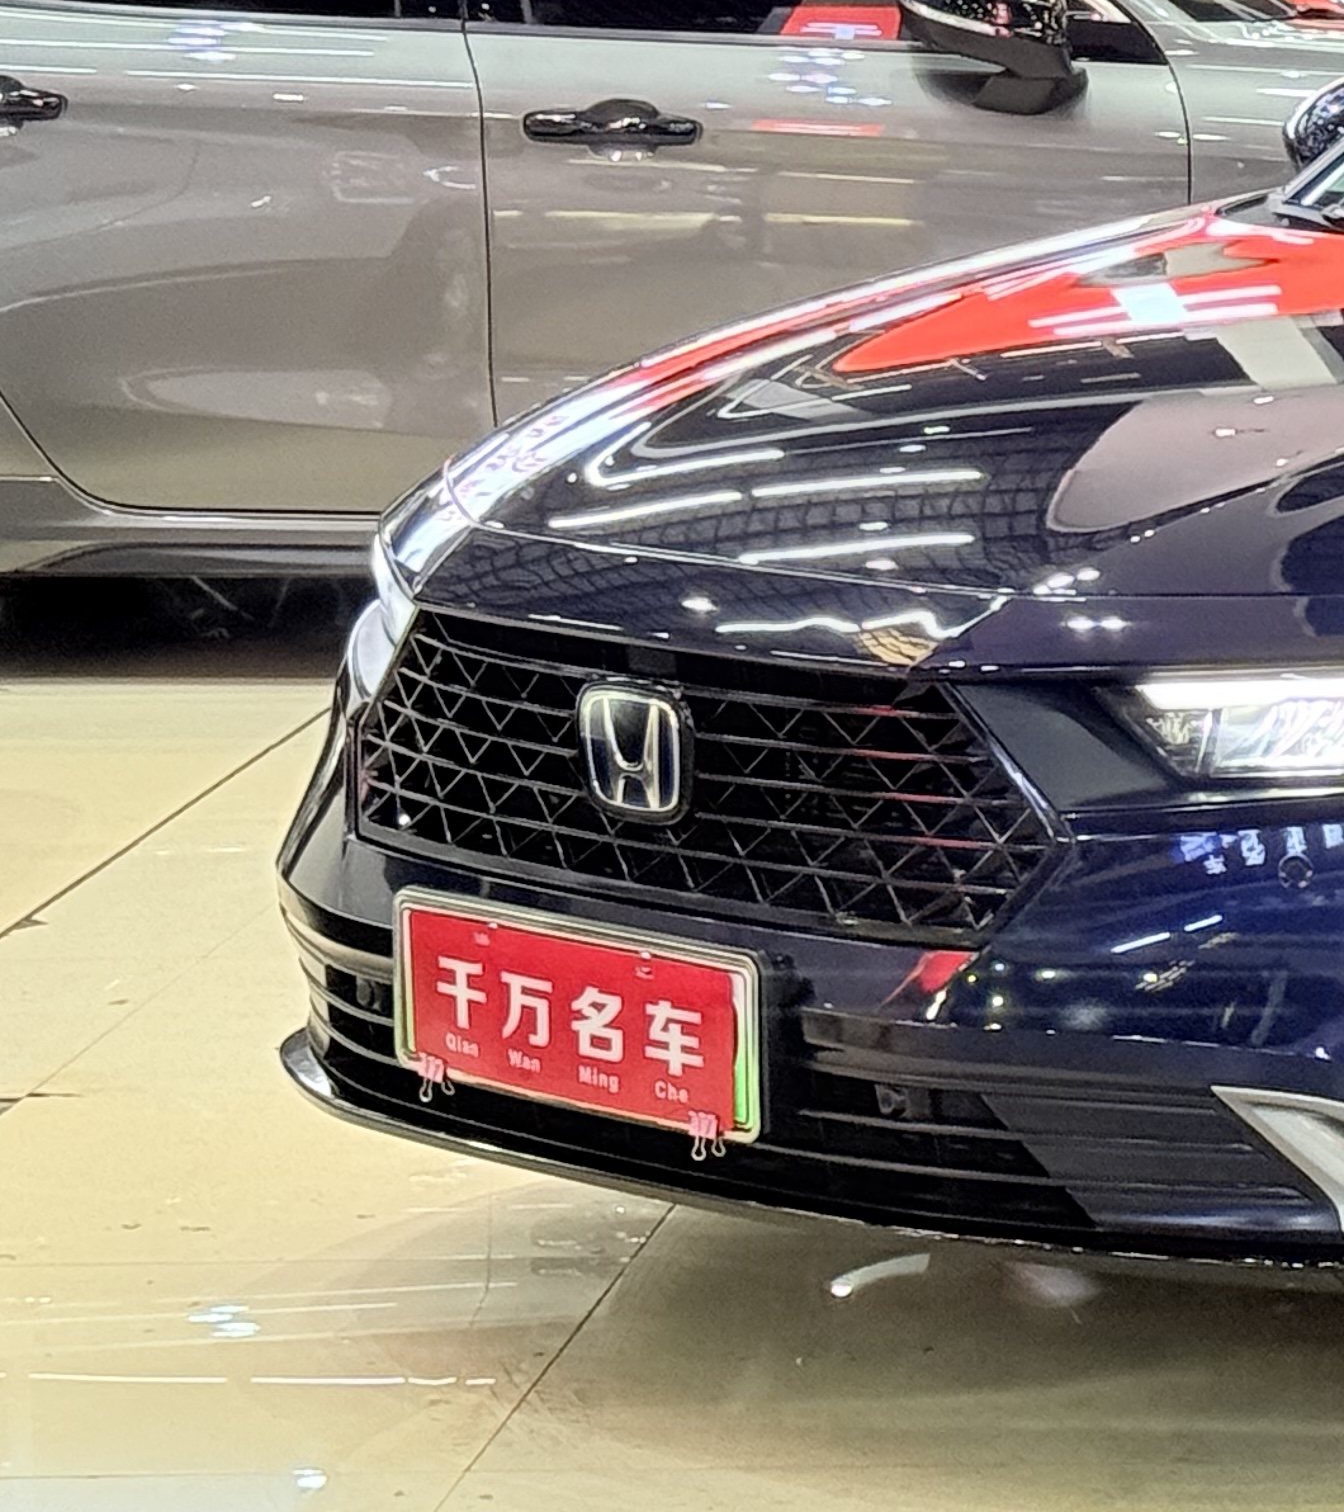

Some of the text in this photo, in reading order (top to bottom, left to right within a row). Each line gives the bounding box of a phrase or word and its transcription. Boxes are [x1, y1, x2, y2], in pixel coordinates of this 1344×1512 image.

[436, 955, 704, 1077] 千万名车
[445, 1032, 690, 1104] Qian Wan Ming Che
